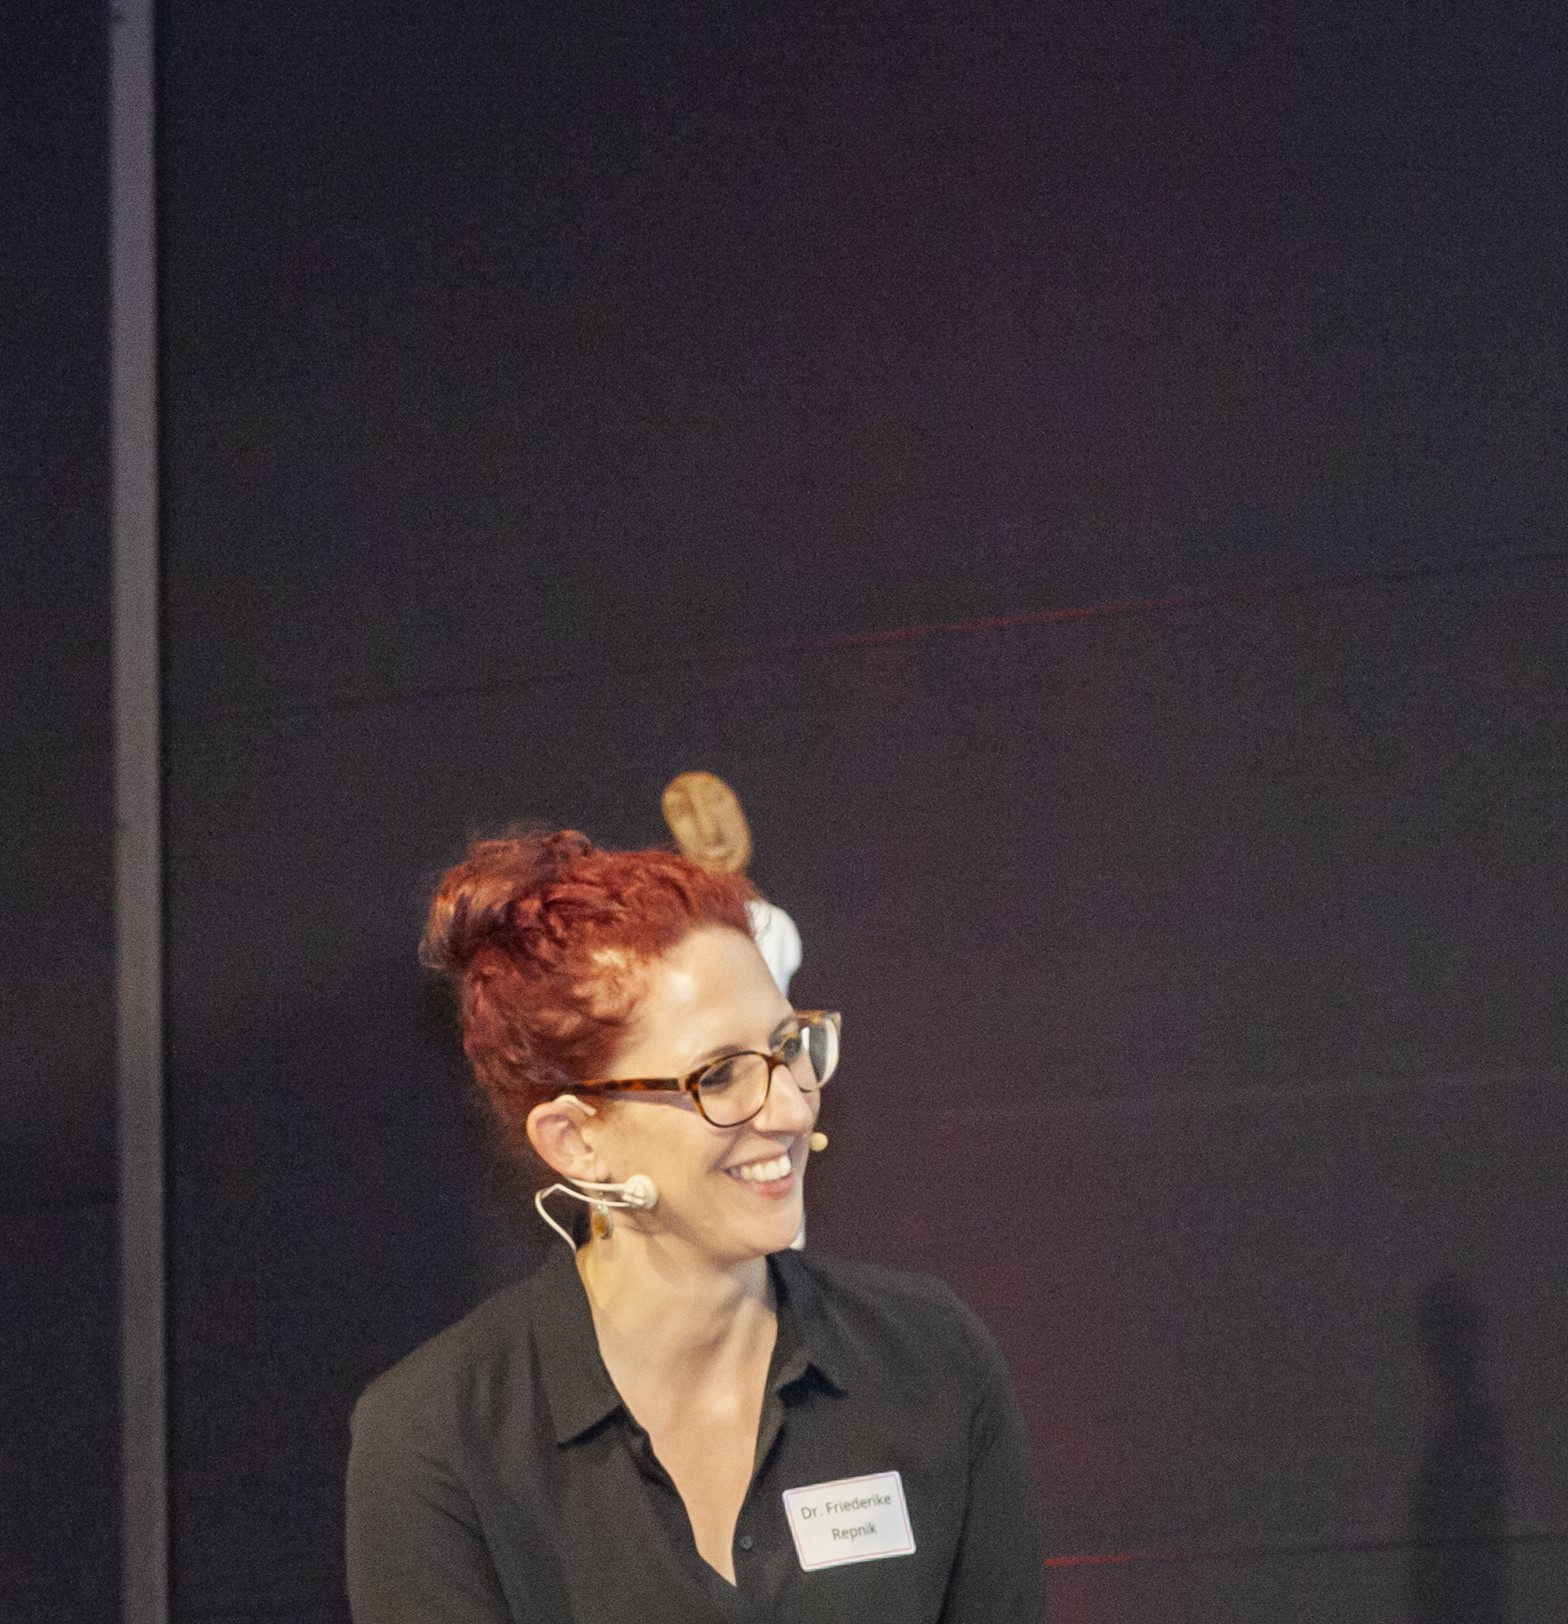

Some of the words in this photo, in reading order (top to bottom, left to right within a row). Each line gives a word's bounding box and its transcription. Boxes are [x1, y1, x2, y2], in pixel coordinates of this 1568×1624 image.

[801, 1506, 823, 1520] Dr.
[825, 1494, 892, 1514] Friederike
[831, 1522, 878, 1542] Repnik
